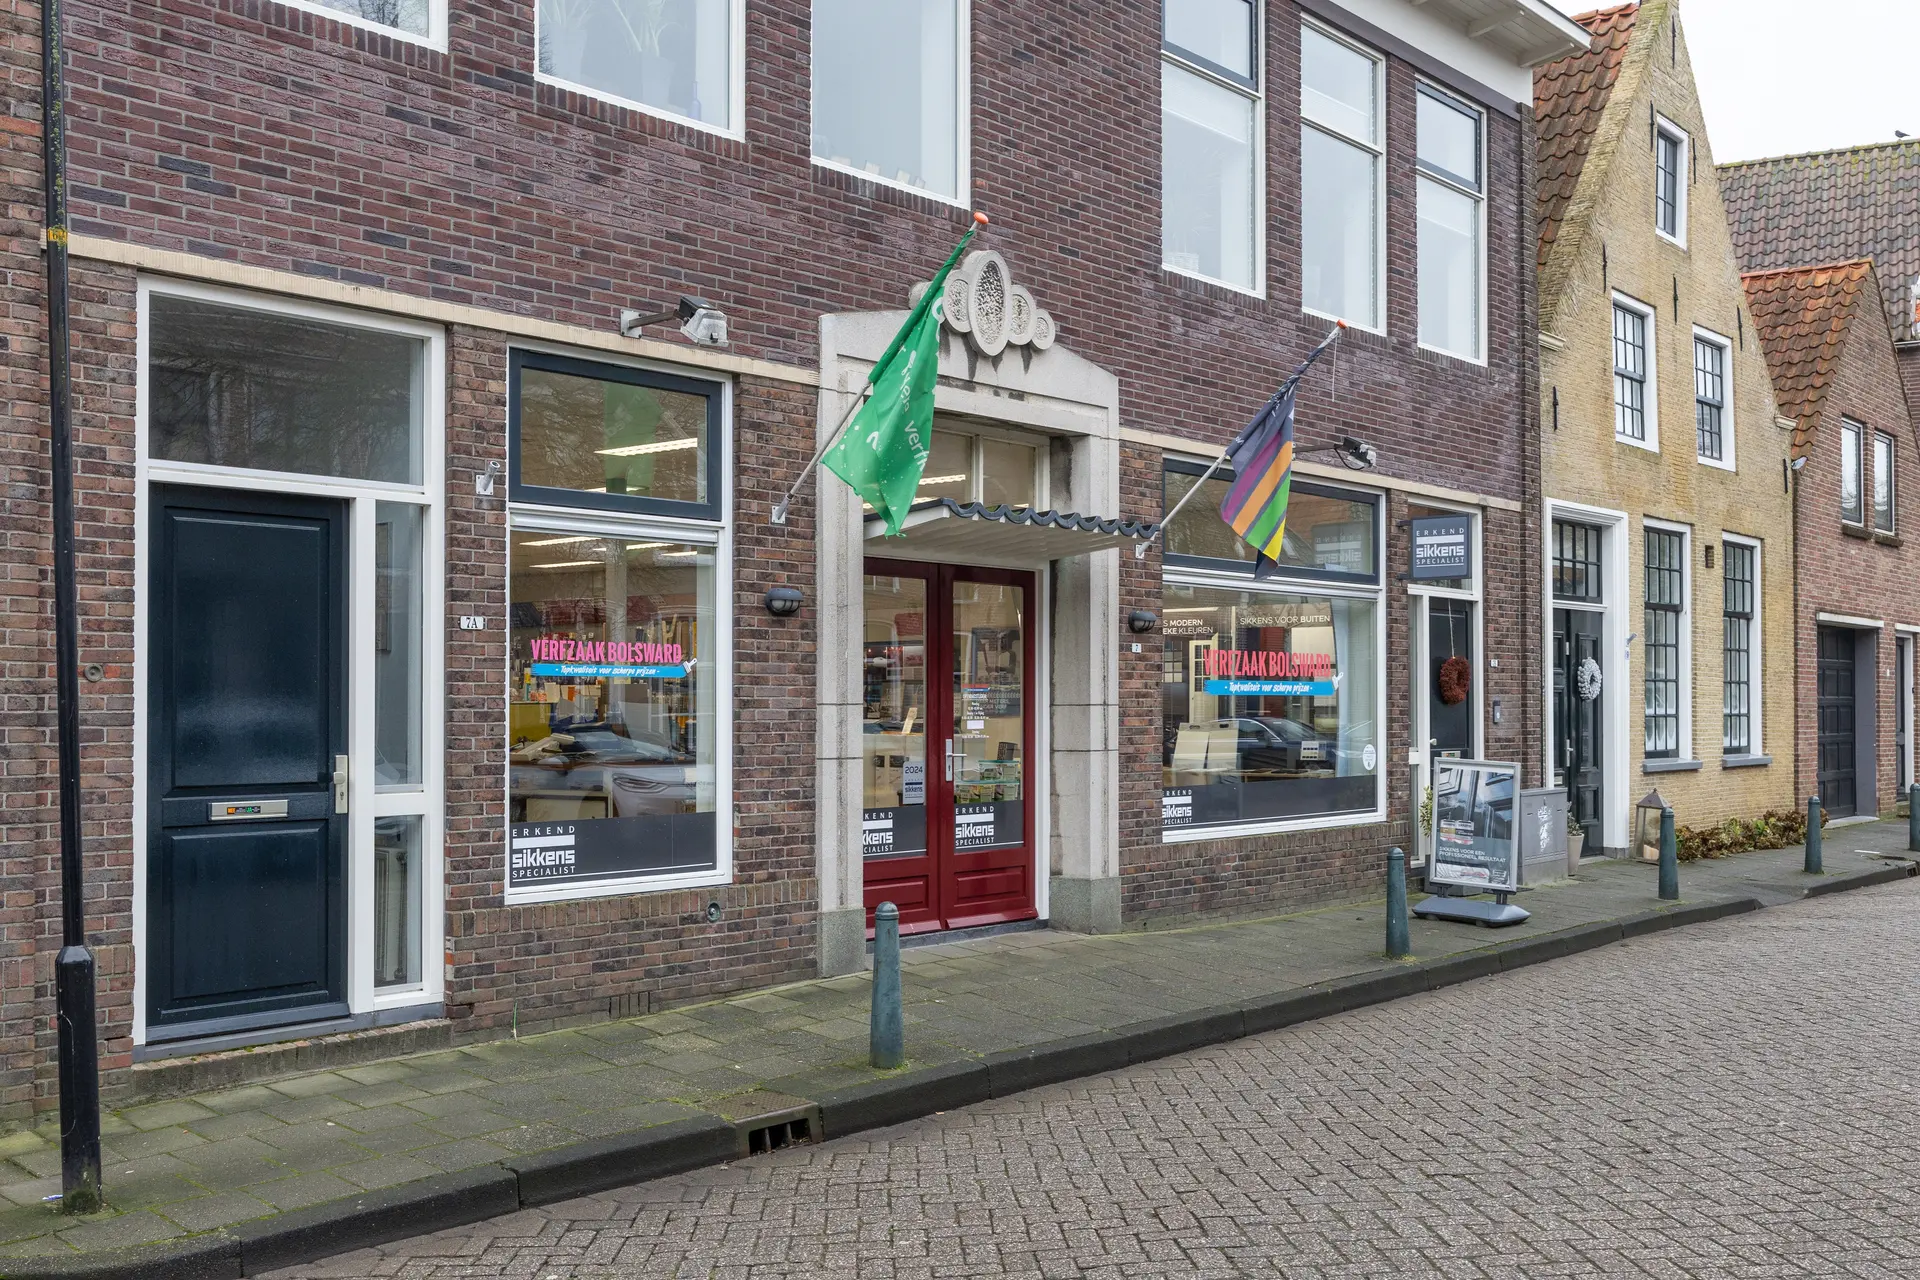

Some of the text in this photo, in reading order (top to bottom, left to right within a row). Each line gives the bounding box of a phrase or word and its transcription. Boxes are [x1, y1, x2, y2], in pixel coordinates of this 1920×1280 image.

[1416, 528, 1464, 536] ERKEND
[1416, 544, 1465, 558] sikkens
[1416, 557, 1465, 565] SPECIALIST
[466, 617, 478, 629] 7A
[1162, 619, 1203, 627] S MODERN
[1239, 615, 1331, 625] SIKKENS VOOR BUITEN
[1162, 627, 1213, 635] EKE KLEUREN
[530, 639, 682, 664] VERFZAAK BOLSWARD
[1203, 649, 1331, 677] VERFZAAK BOLSWARD
[560, 665, 597, 675] Topkwaliteit
[635, 667, 656, 677] prijzen
[1229, 682, 1261, 693] Topkwaliteit
[1272, 683, 1292, 694] scherpe
[1291, 683, 1310, 696] prijzen
[904, 766, 923, 774] 2024
[864, 811, 893, 820] KEND
[955, 806, 994, 815] ERKEND
[512, 825, 575, 837] ERKEND
[955, 823, 995, 839] sikkens
[955, 836, 995, 847] SPECIALIST
[863, 844, 893, 854] CIALIST
[512, 848, 575, 868] sikkens
[512, 865, 576, 878] SPECIALIST
